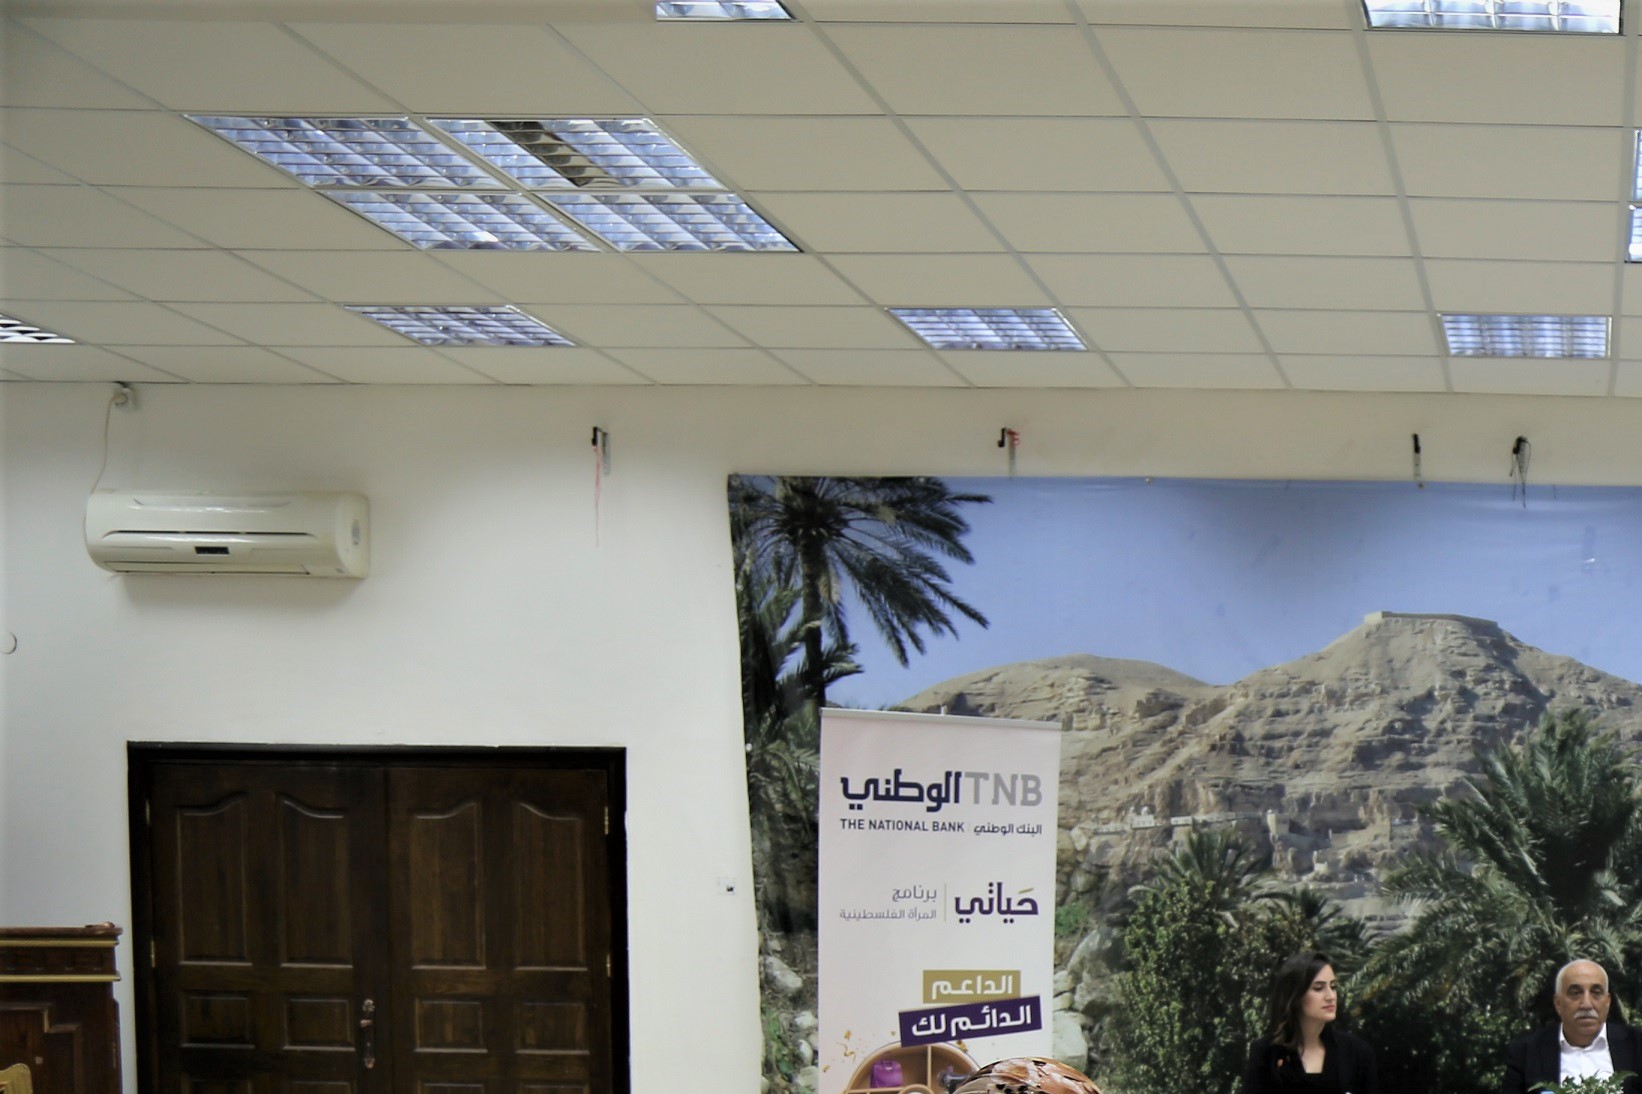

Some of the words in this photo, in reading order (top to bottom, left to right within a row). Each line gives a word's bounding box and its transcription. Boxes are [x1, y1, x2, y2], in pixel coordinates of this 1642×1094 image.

[840, 768, 962, 812] الوطني
[964, 771, 1043, 806] TNB
[840, 818, 865, 830] THE
[868, 820, 929, 832] NATIONAL
[932, 821, 965, 833] BANK
[973, 822, 1014, 836] الوطني
[1016, 824, 1043, 837] البنك
[892, 885, 938, 903] برنامج
[839, 909, 906, 922] الفلسطينية
[907, 908, 937, 922] المرأة
[931, 975, 1013, 1000] الداعم
[911, 1013, 947, 1037] لك
[951, 1004, 1032, 1038] الدائم
